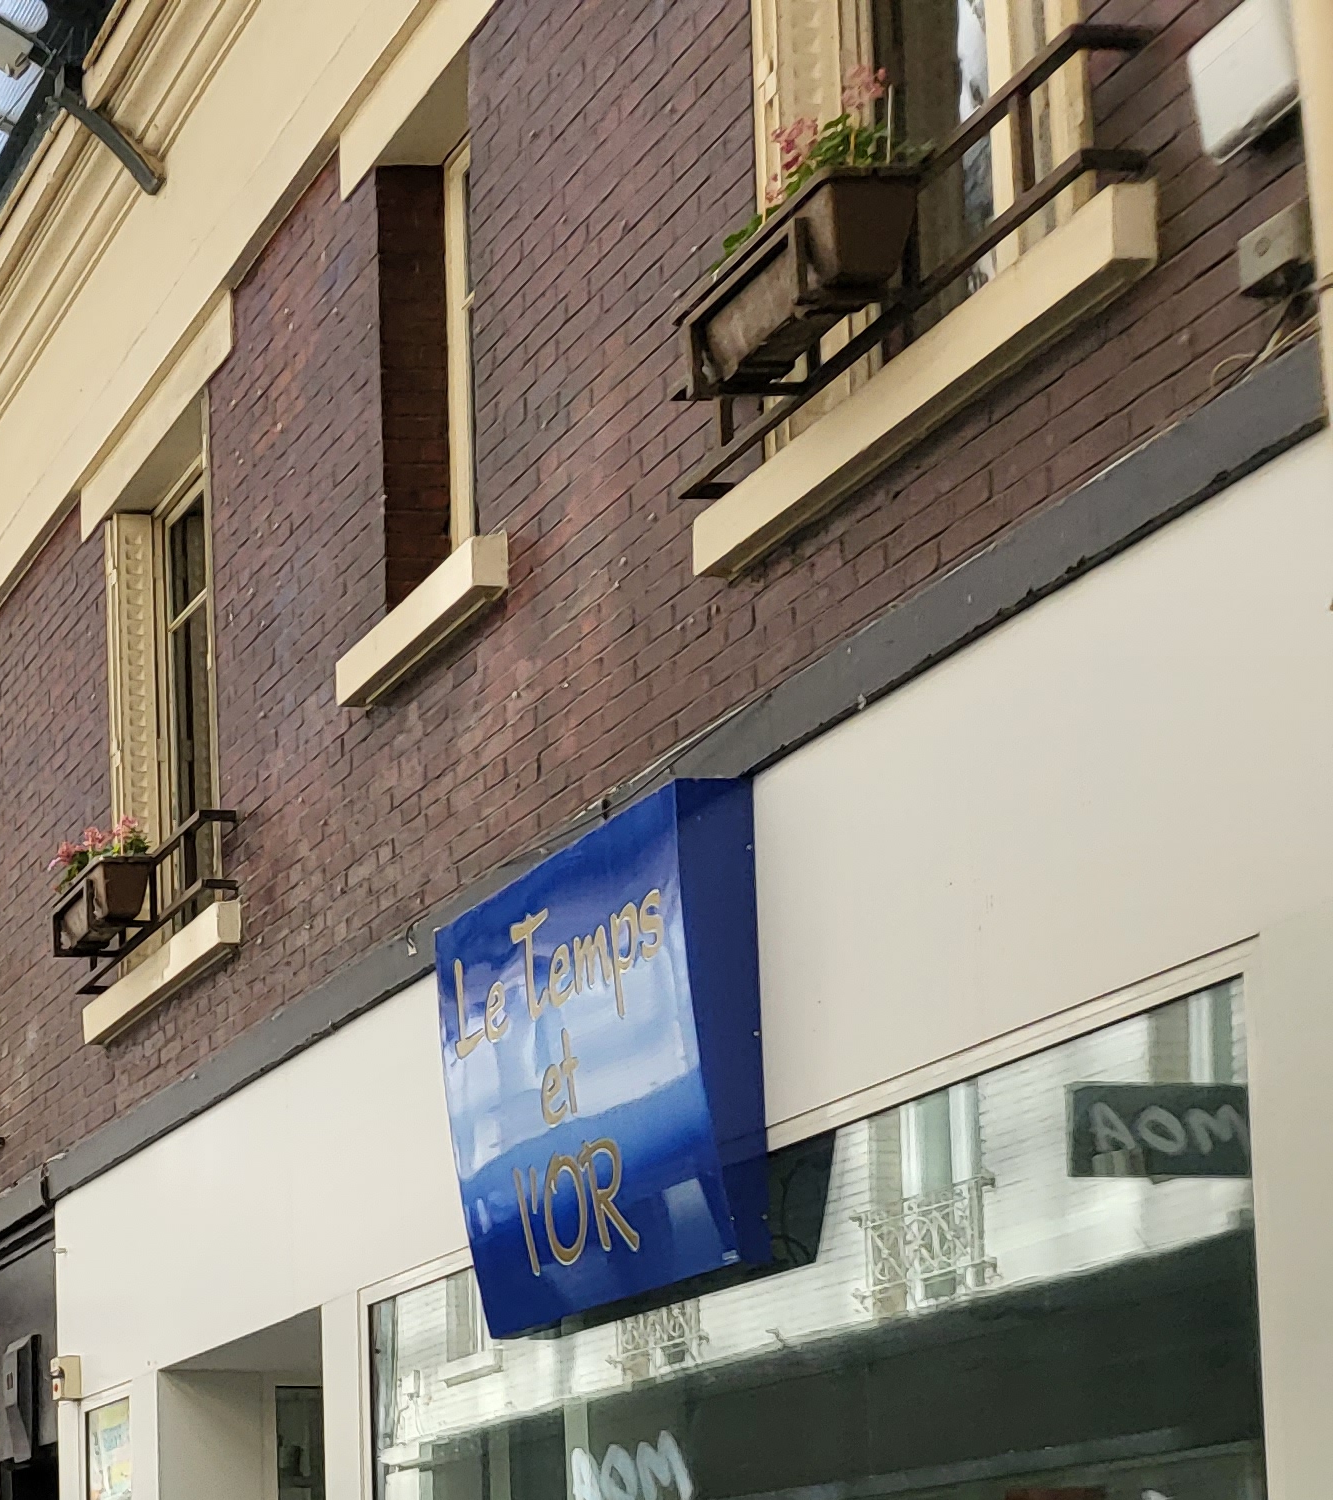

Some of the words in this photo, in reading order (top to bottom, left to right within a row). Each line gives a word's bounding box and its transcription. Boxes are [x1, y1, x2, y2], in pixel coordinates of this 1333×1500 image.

[452, 958, 509, 1060] Le
[510, 888, 664, 1021] Temps
[540, 1028, 580, 1127] et
